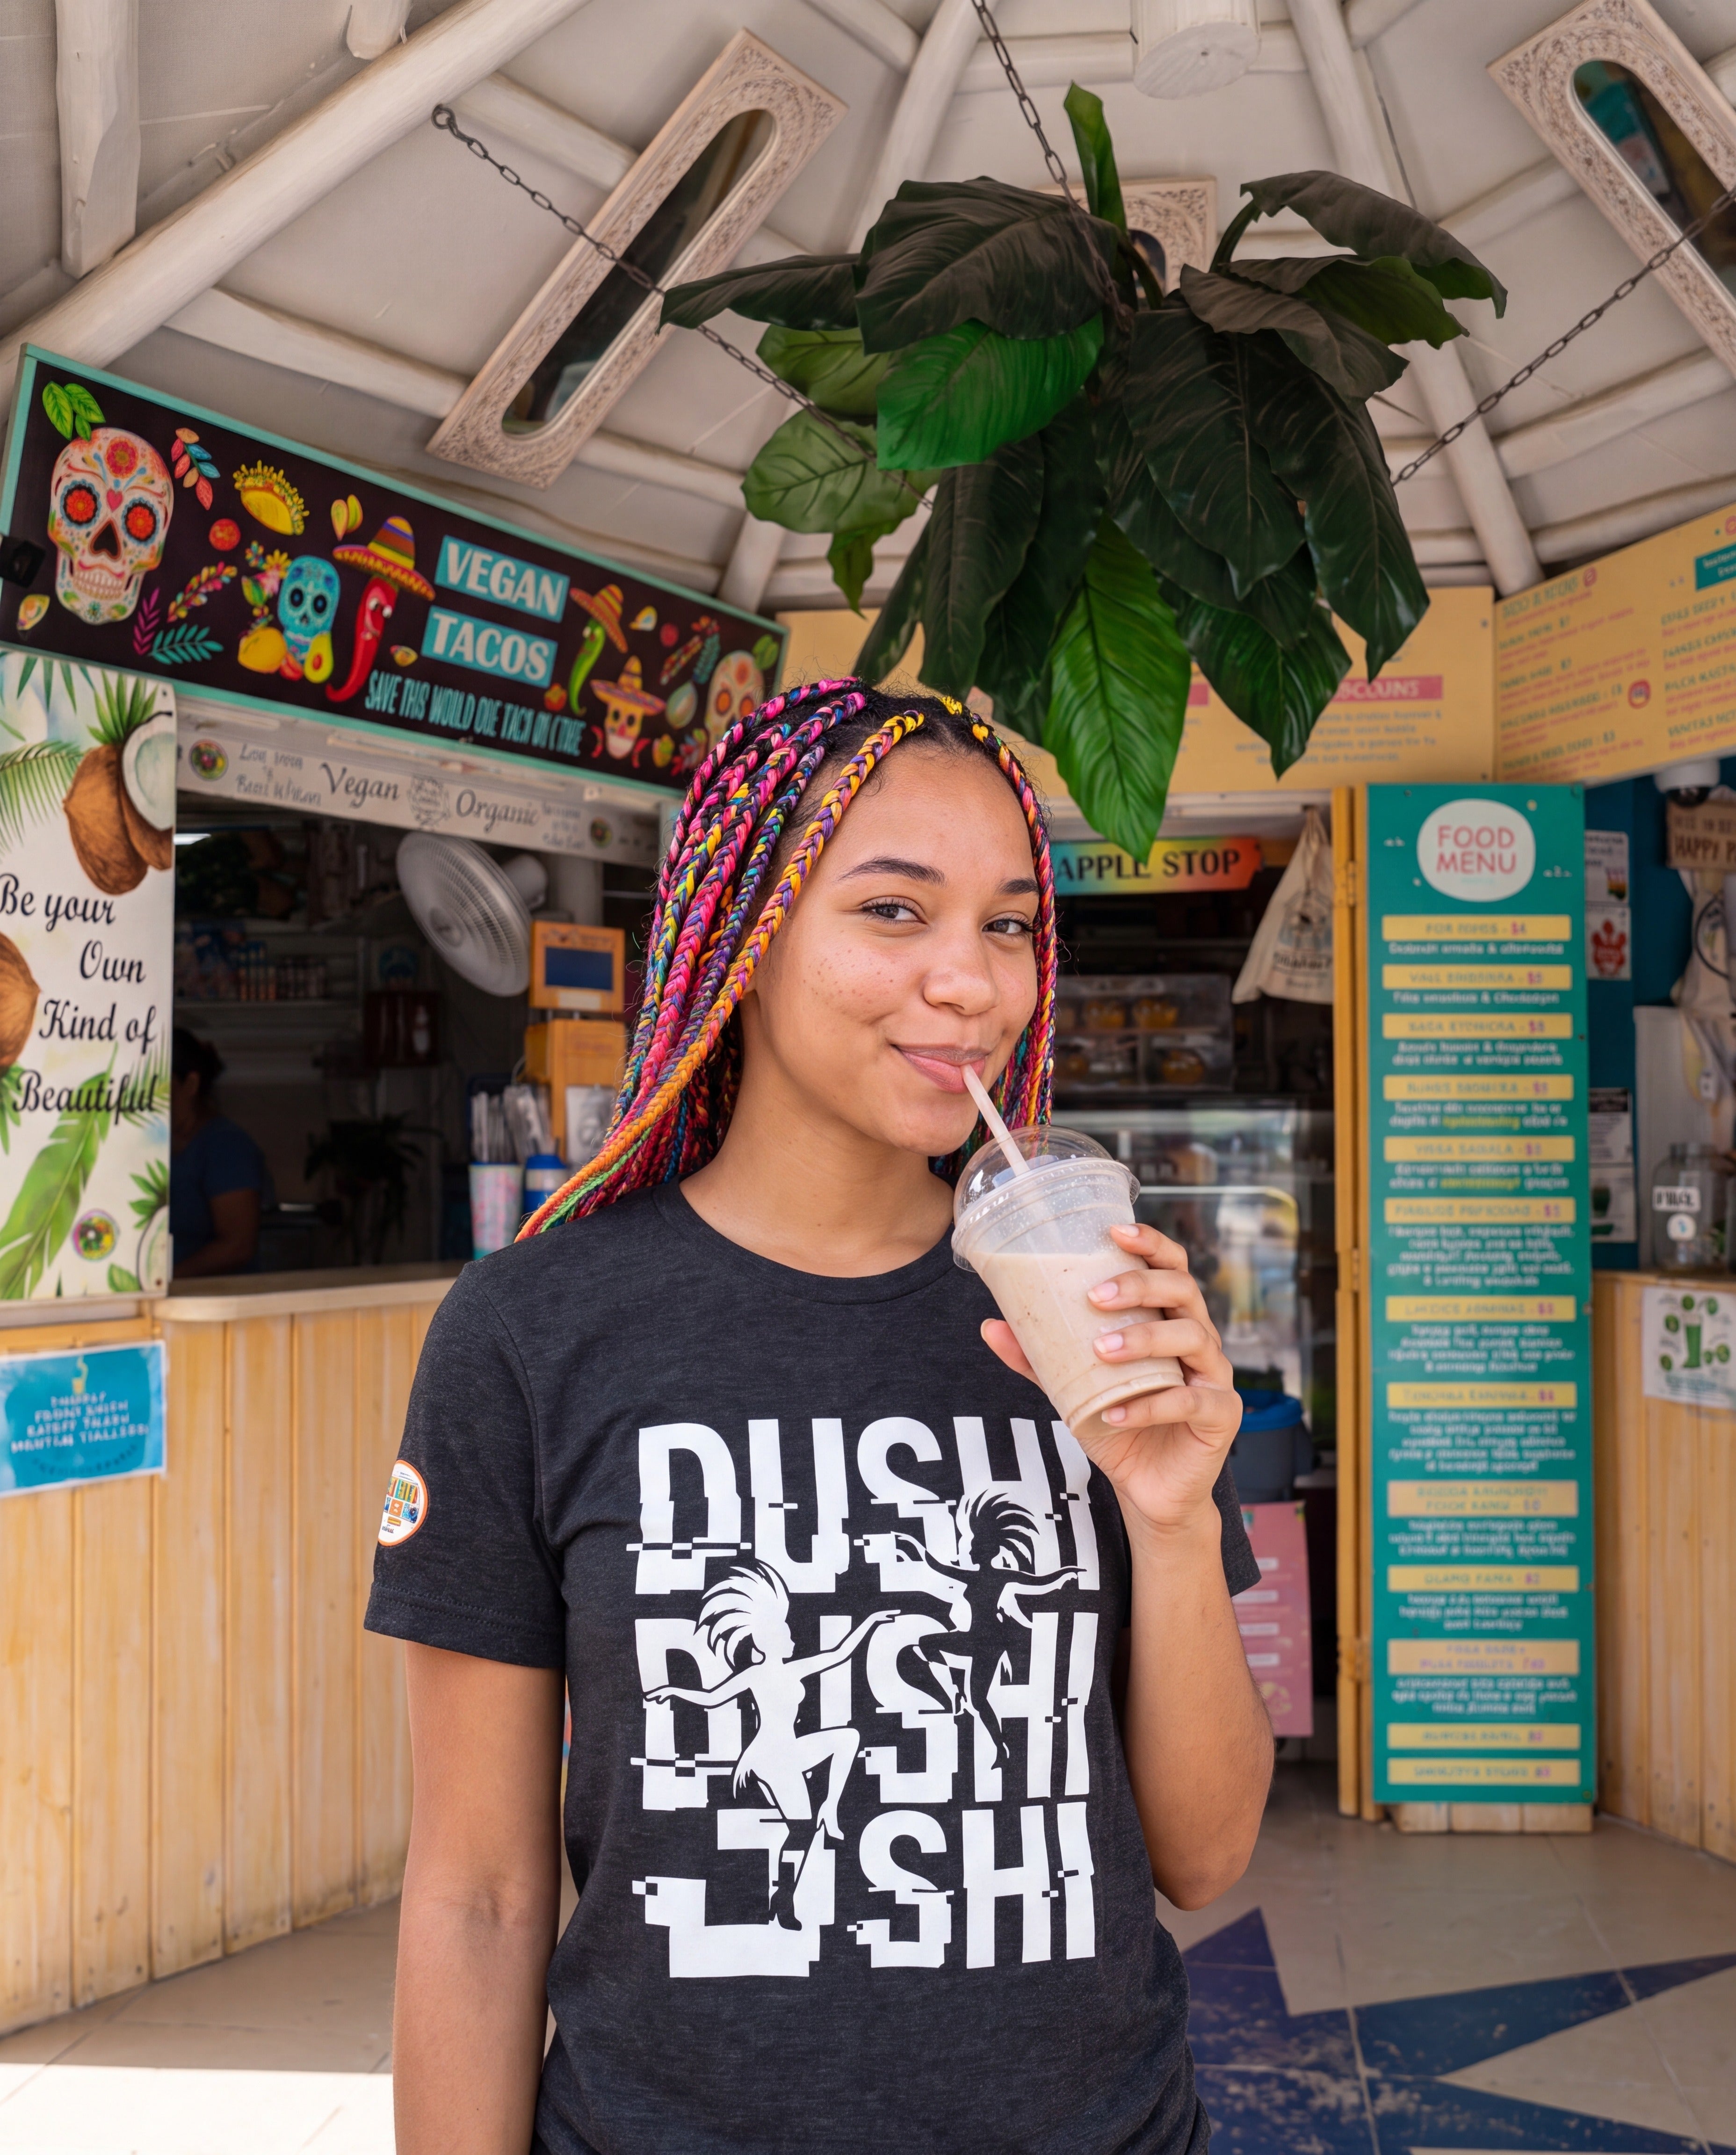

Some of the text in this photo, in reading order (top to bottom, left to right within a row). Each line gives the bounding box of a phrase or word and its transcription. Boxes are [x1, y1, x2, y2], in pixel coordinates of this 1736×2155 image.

[447, 542, 563, 616] VEGAN
[433, 613, 549, 680] TACOS
[365, 669, 401, 714] SAVE
[399, 678, 430, 721] THIS
[321, 762, 399, 809] Vegan
[456, 788, 539, 833] Organic
[1436, 851, 1517, 875] MENU
[1437, 825, 1515, 849] FOOD
[1163, 849, 1240, 878] STOP
[0, 873, 116, 933] Be your
[80, 939, 146, 984] Own
[39, 998, 158, 1055] Kind of
[13, 1069, 158, 1125] Beautiful
[626, 1416, 1100, 1594] DUSHI
